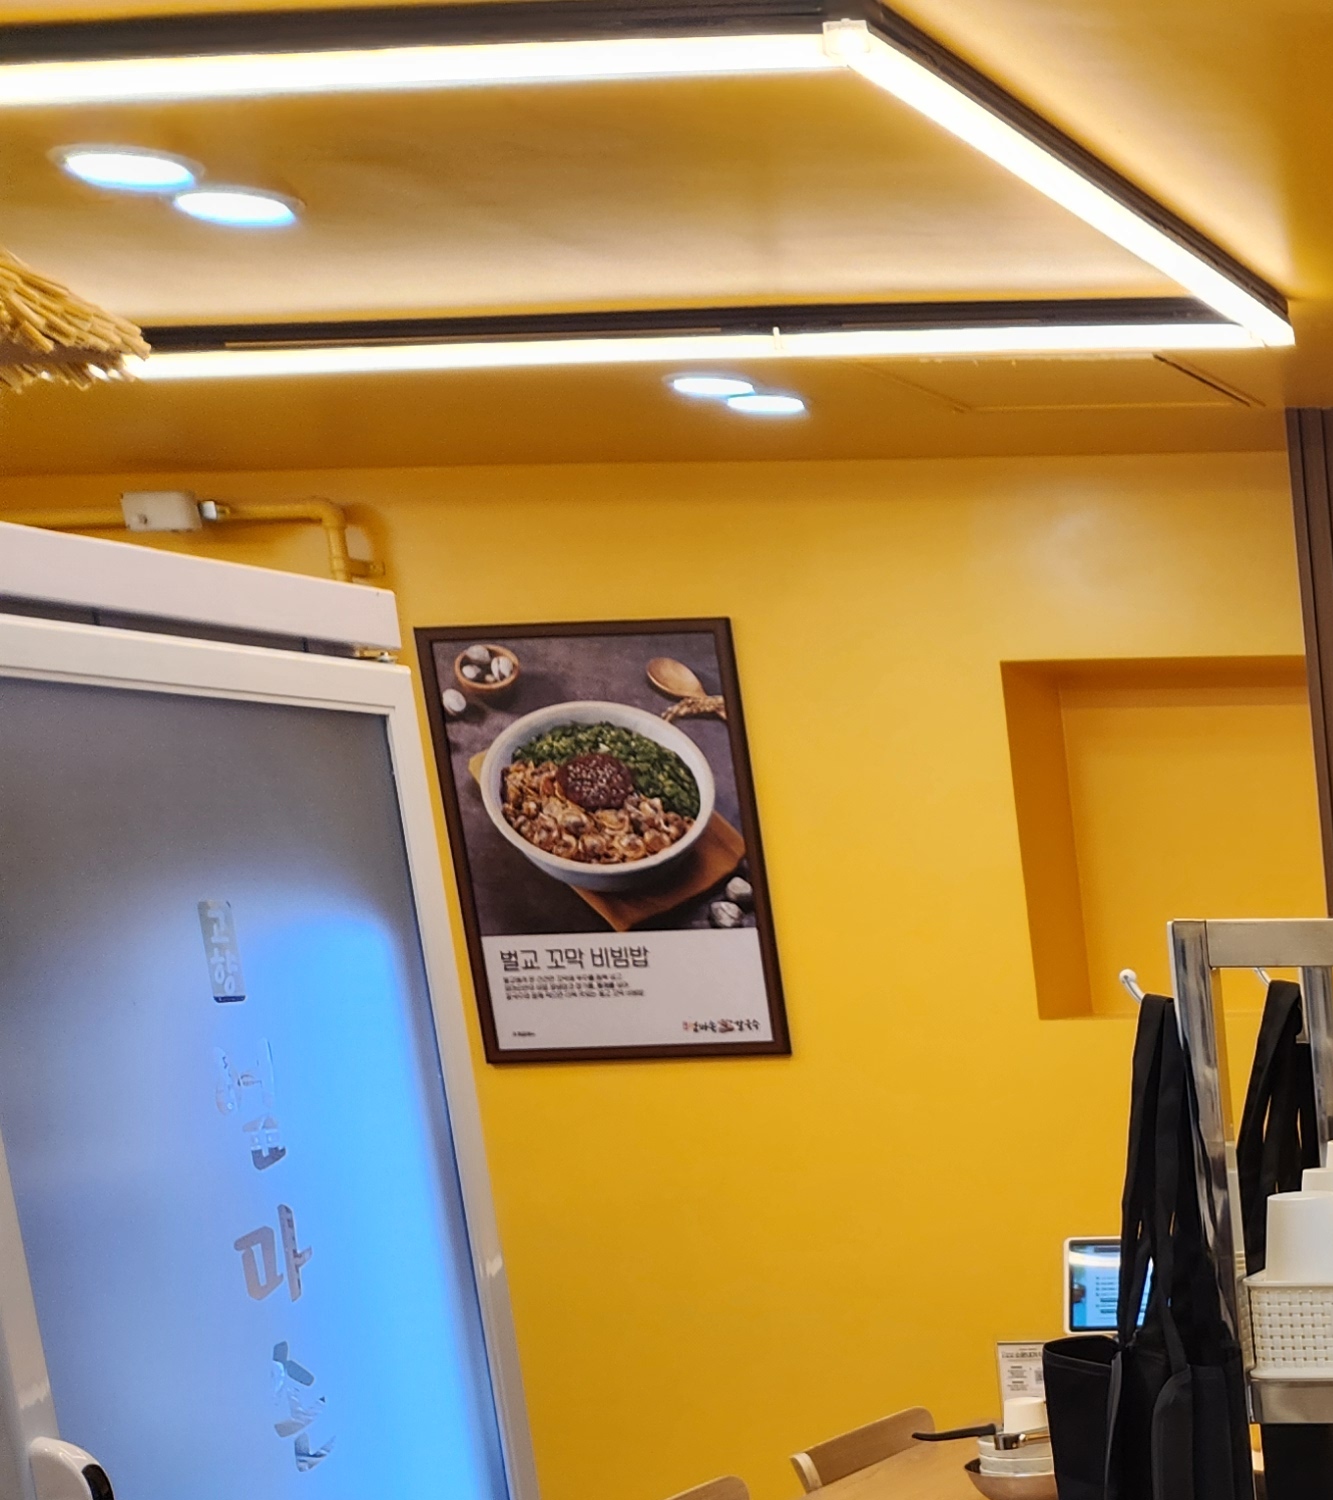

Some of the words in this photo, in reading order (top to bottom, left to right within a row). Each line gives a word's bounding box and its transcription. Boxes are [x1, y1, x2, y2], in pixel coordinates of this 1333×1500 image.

[500, 949, 541, 972] 벌교
[545, 948, 585, 969] 꼬막
[590, 946, 650, 969] 비빔밥
